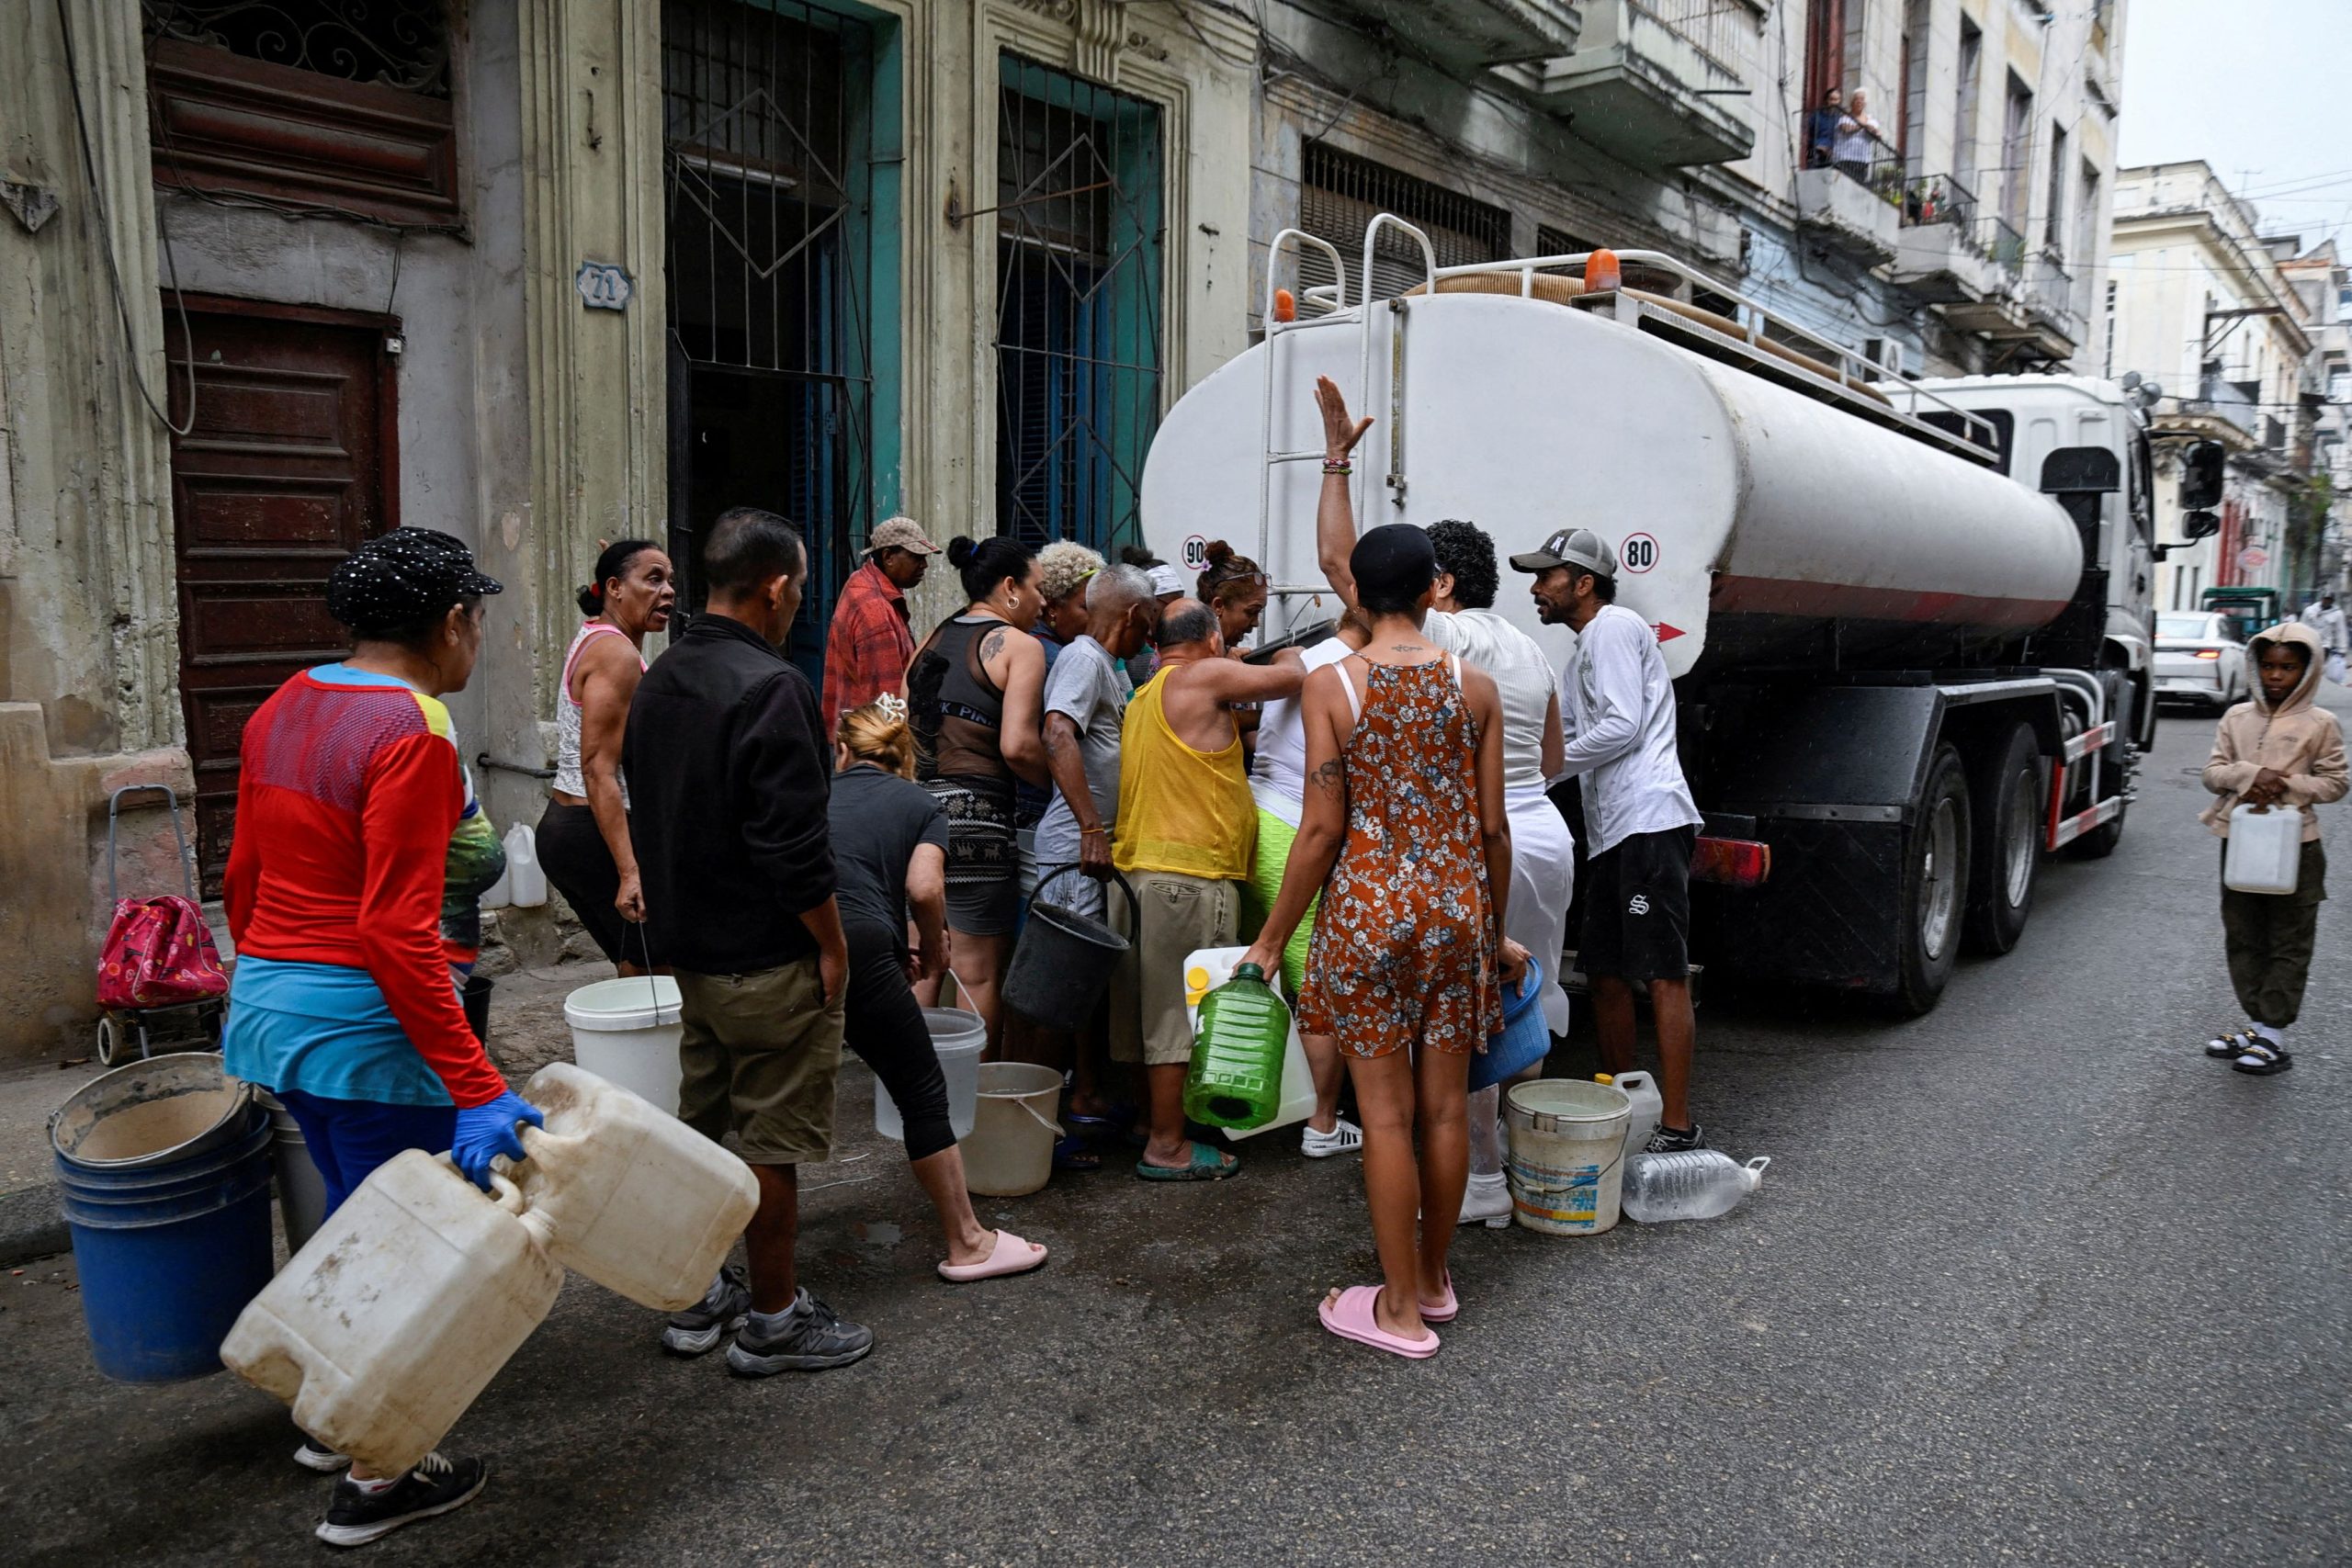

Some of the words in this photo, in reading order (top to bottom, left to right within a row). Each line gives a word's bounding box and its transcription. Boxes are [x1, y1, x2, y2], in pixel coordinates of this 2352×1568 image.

[591, 272, 616, 301] 71
[1186, 541, 1204, 564] 90
[1627, 540, 1652, 567] 80
[1628, 894, 1650, 916] S
